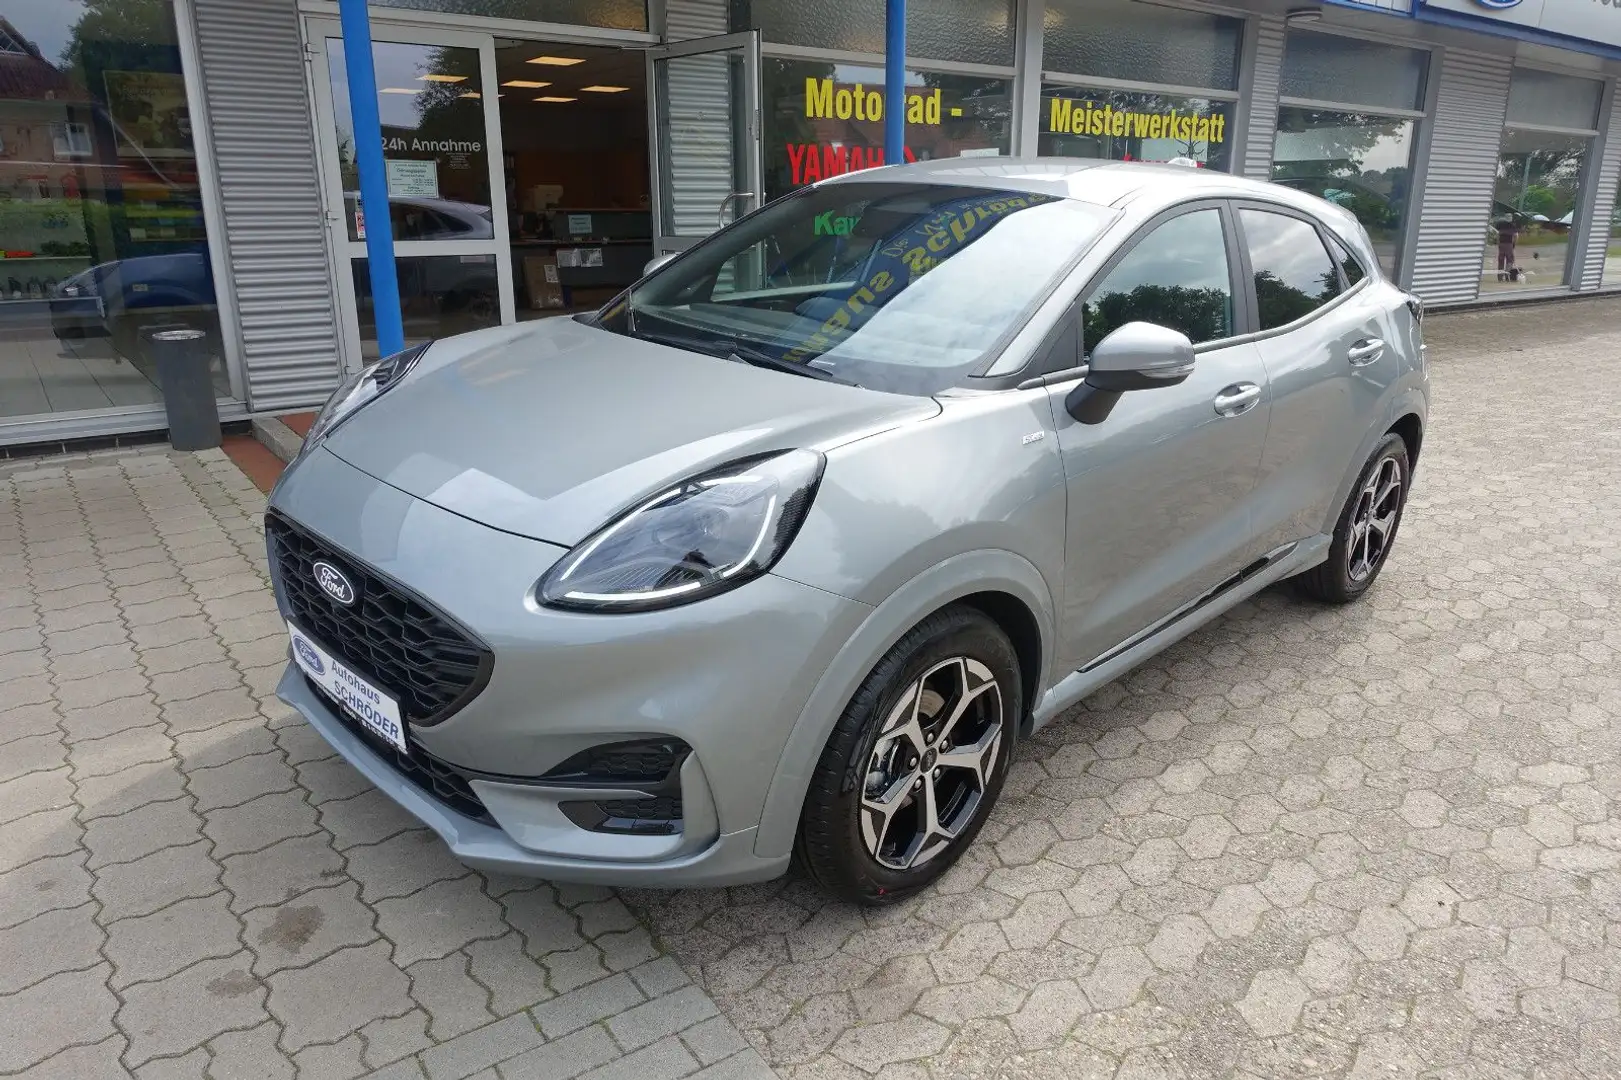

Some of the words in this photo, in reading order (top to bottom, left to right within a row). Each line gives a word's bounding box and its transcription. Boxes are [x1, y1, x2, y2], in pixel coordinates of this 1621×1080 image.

[805, 77, 941, 125] Motoad
[1050, 98, 1225, 143] Meisterwerkstatt
[381, 137, 407, 151] 24h
[411, 137, 481, 152] Annahme
[786, 143, 917, 186] YAMAH
[320, 567, 345, 599] Ford
[331, 660, 380, 705] Autohaus
[334, 680, 399, 740] SCHRÖDER
